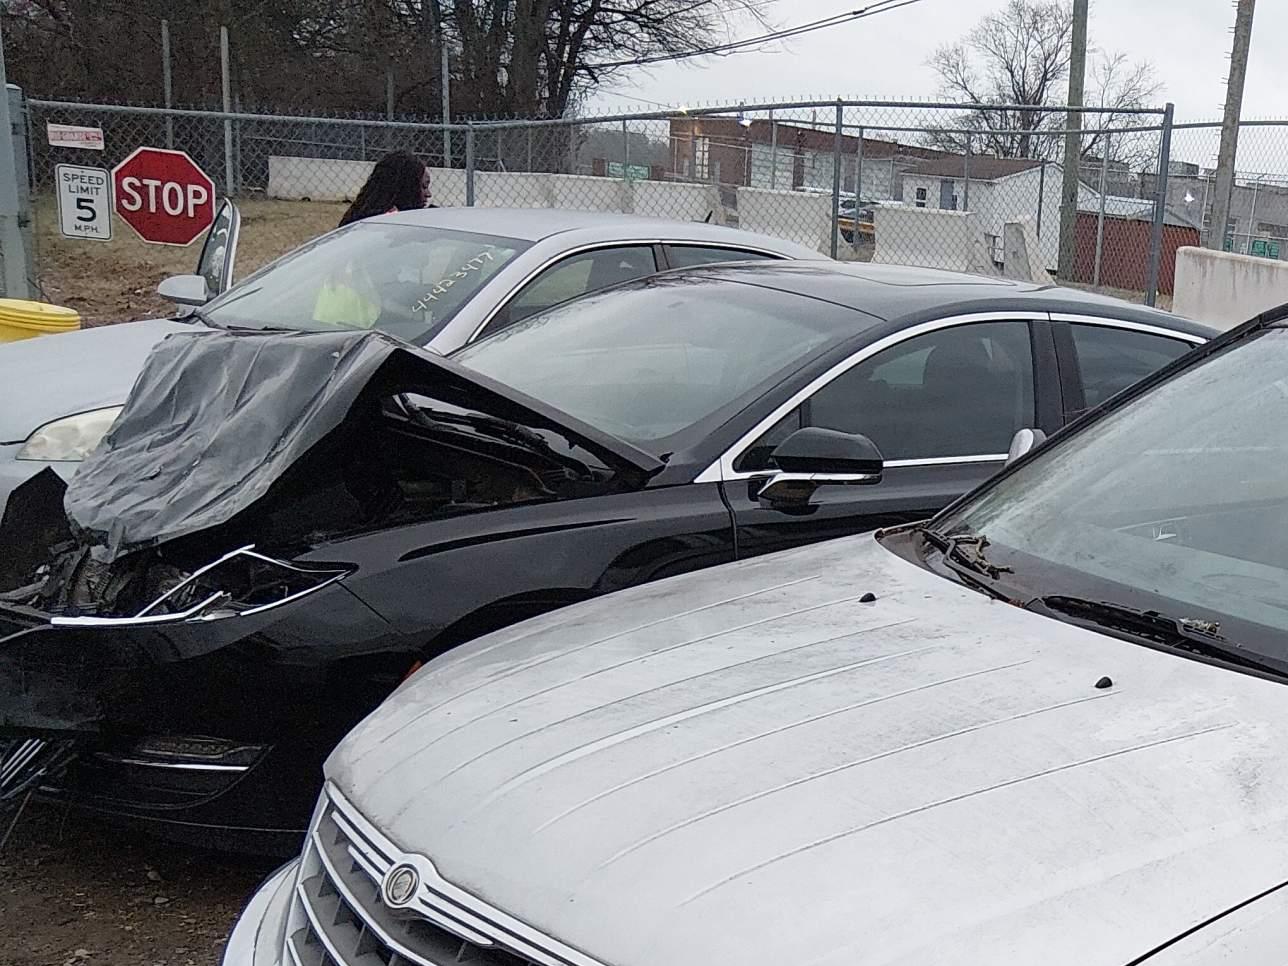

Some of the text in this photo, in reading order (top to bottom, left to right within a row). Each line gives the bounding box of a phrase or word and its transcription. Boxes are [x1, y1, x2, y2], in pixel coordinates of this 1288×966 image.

[63, 172, 104, 186] SPEED
[68, 184, 101, 196] LIMIT
[121, 177, 208, 217] STOP
[76, 197, 97, 222] 5
